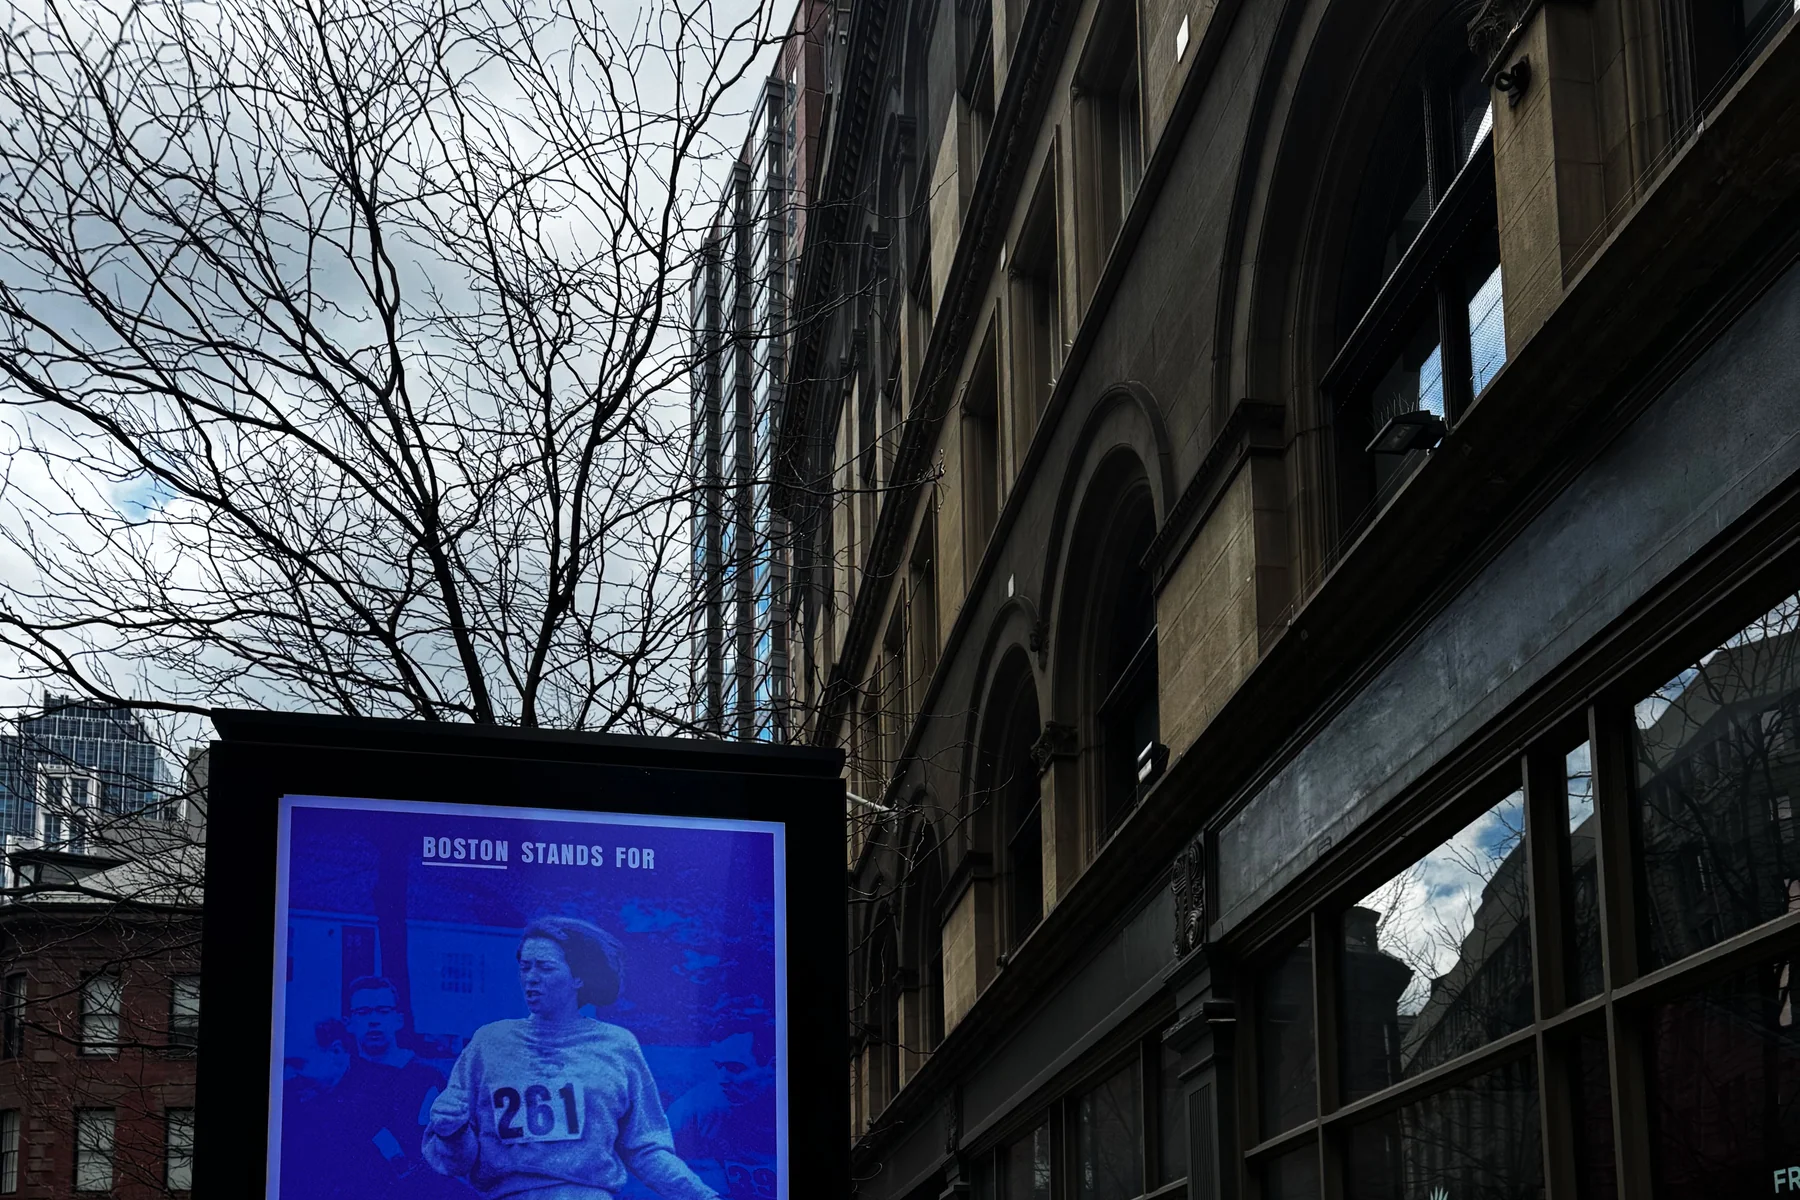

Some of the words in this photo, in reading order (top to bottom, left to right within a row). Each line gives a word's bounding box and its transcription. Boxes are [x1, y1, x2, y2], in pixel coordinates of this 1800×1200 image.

[422, 836, 509, 862] BOSTON
[521, 841, 604, 867] STANDS
[615, 847, 655, 870] FOR
[493, 1082, 580, 1139] 261
